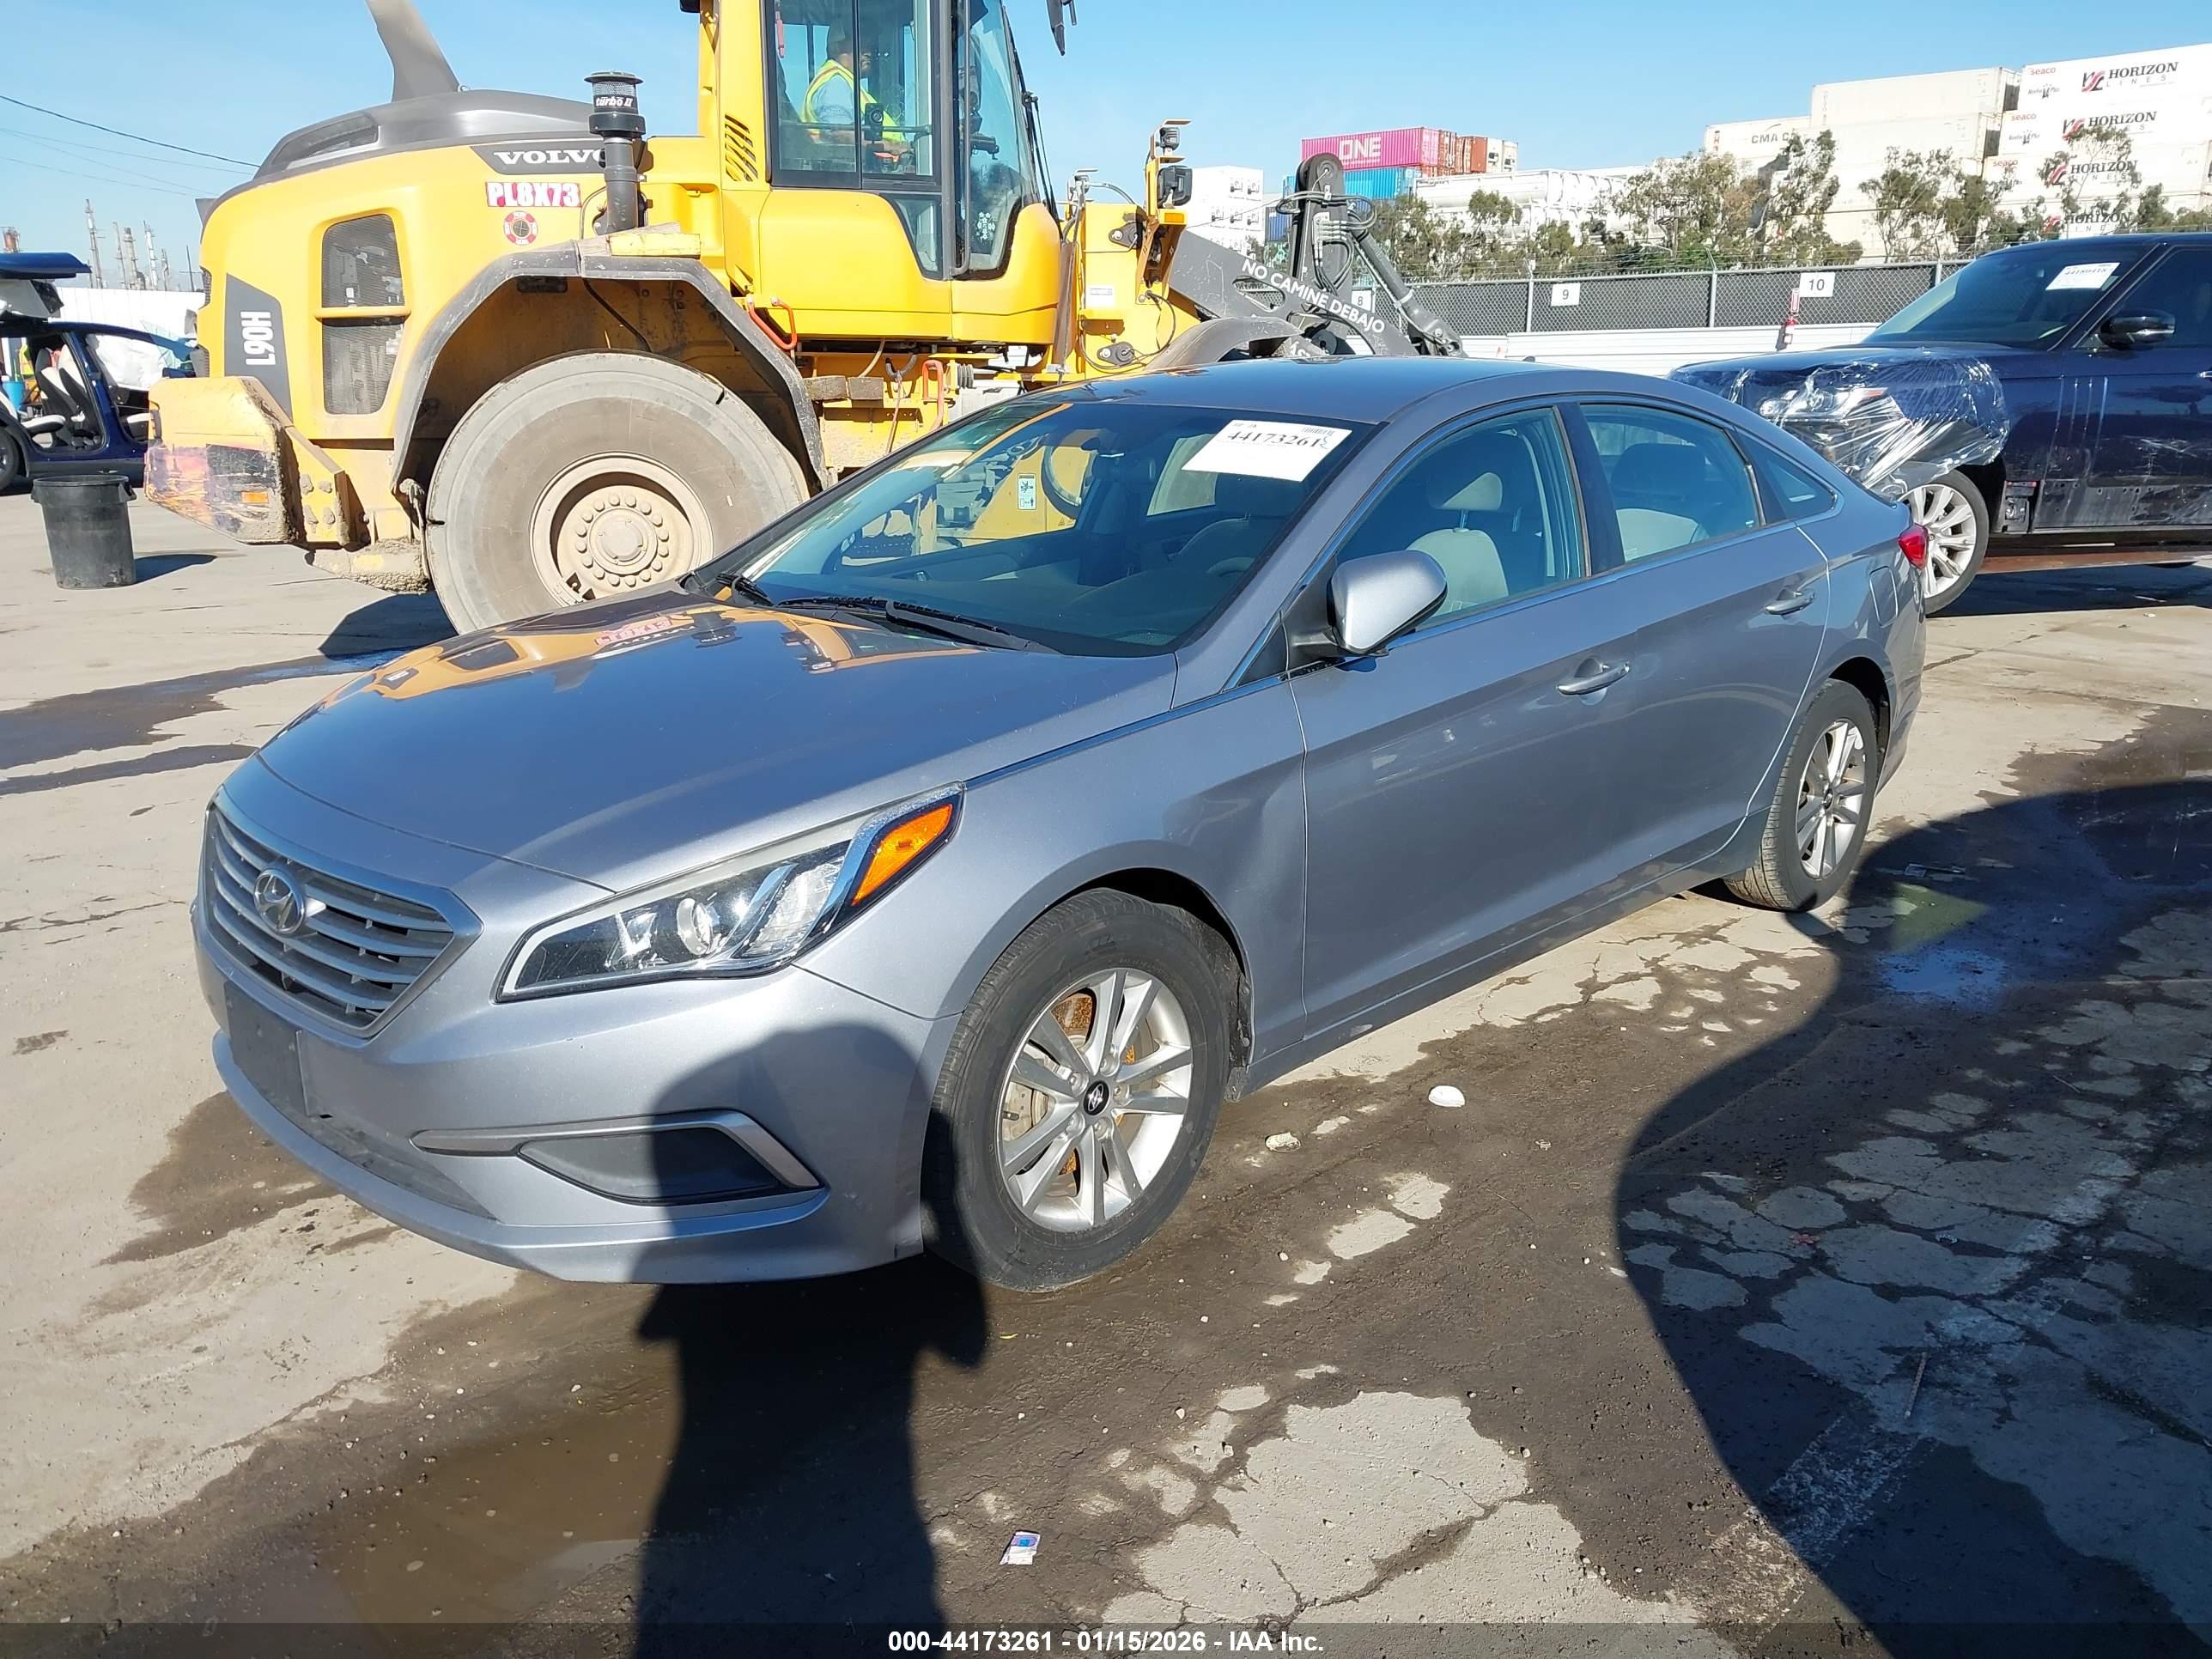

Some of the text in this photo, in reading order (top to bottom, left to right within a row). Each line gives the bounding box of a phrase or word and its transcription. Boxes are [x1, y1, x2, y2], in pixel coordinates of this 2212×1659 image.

[2108, 62, 2179, 79] HORIZON
[2088, 111, 2157, 127] HORIZON
[1752, 133, 1778, 143] CMA
[1339, 137, 1382, 161] ONE
[2070, 161, 2138, 174] HORIZON
[1809, 279, 1825, 291] 10
[1242, 258, 1267, 279] NO
[1329, 300, 1385, 333] DEBAJO
[1358, 296, 1364, 306] 8
[1562, 289, 1570, 301] 9
[240, 311, 276, 366] L90H
[1227, 431, 1321, 448] 44173261
